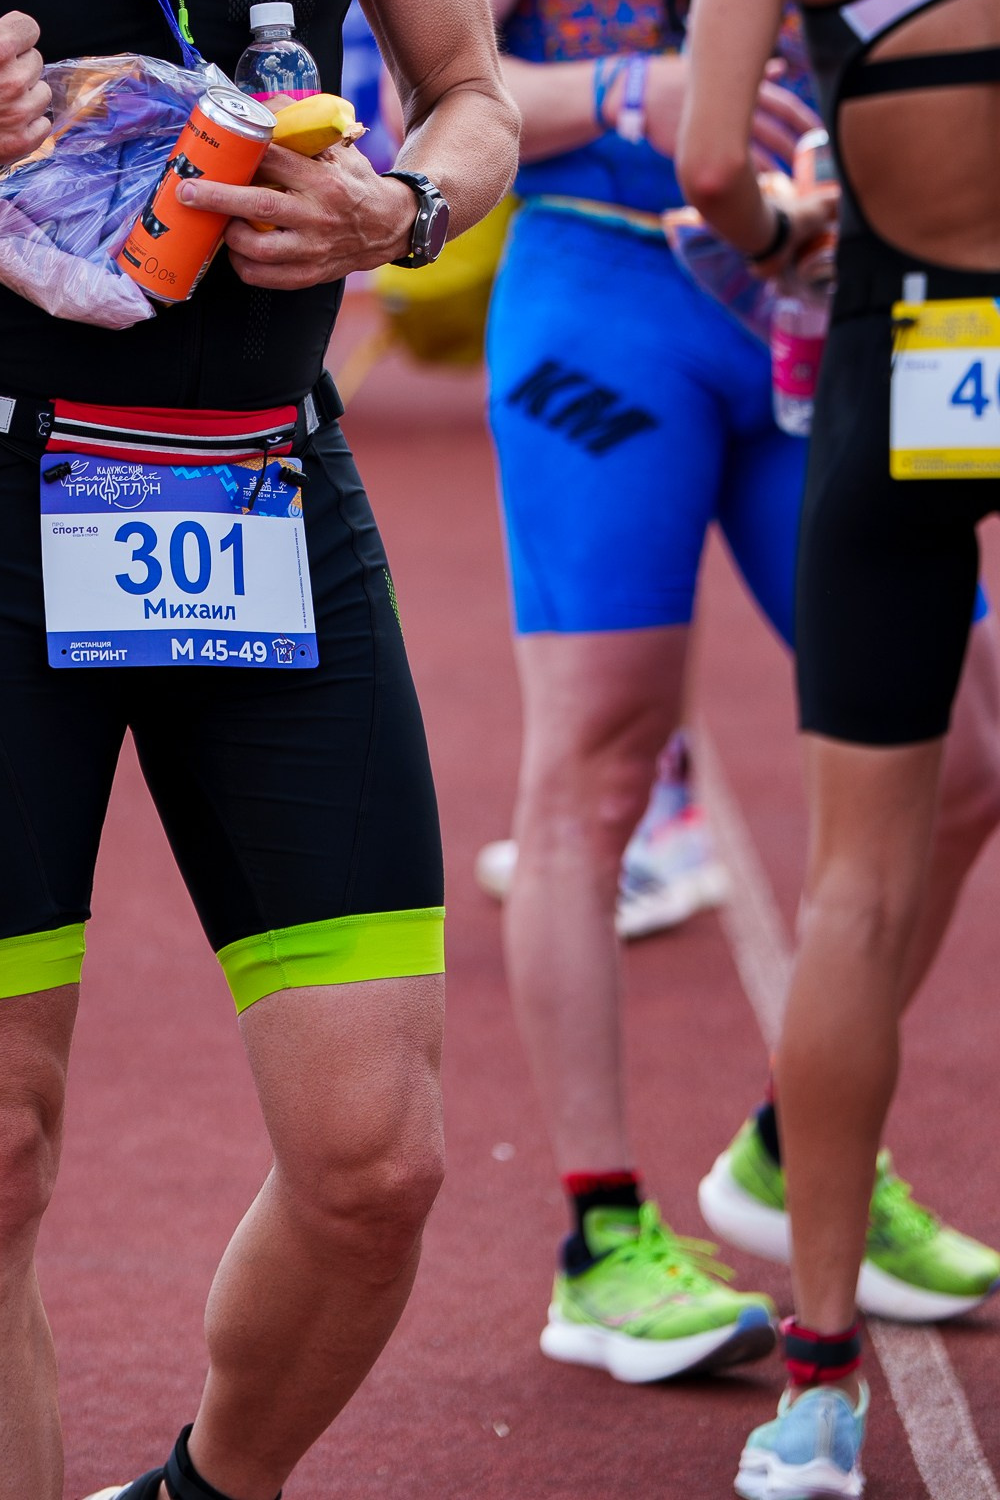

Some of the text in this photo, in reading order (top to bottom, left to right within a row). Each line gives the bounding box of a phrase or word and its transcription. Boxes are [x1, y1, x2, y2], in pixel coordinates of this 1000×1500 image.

[200, 131, 220, 148] Bräu
[144, 257, 177, 285] 0,0%
[950, 361, 1000, 417] 4
[96, 464, 143, 475] КАЛУЖСКИЙ
[65, 478, 161, 504] ТРИАТЛОН
[52, 526, 99, 534] СПОРТ 40
[114, 520, 245, 596] 301
[143, 598, 236, 621] Михаил
[69, 641, 111, 649] ДИСТАНЦИЯ
[70, 649, 128, 662] СПРИНТ
[170, 638, 268, 663] М 45-49
